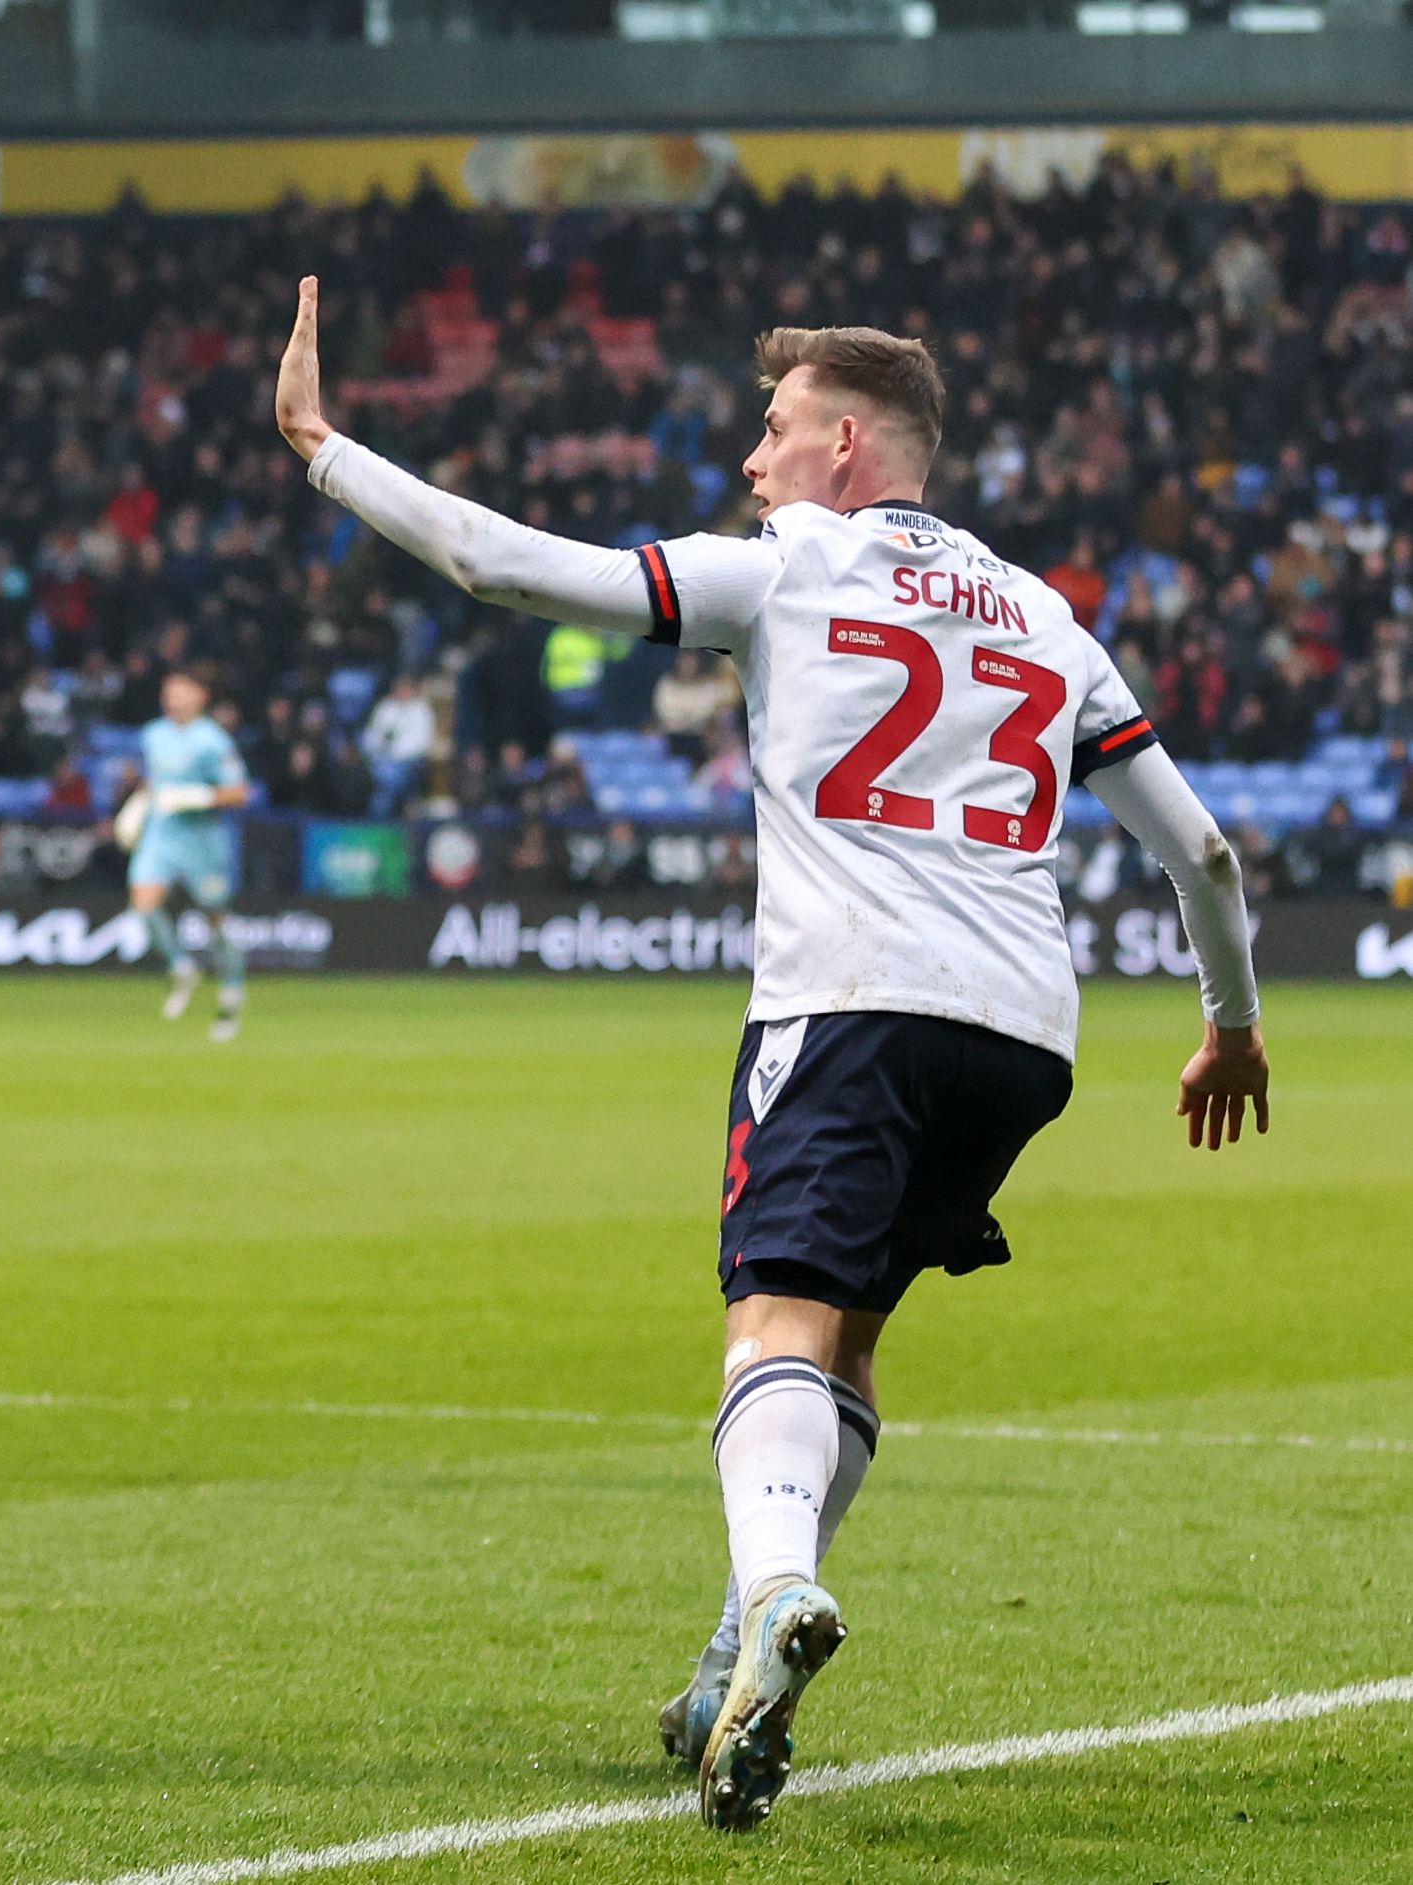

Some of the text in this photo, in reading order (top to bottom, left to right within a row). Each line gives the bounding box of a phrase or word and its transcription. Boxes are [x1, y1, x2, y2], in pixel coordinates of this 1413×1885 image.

[909, 531, 1011, 577] buyer
[892, 566, 1029, 636] SCHÖN
[814, 616, 1067, 854] 23
[868, 808, 883, 818] EFL
[1007, 834, 1021, 846] EFL
